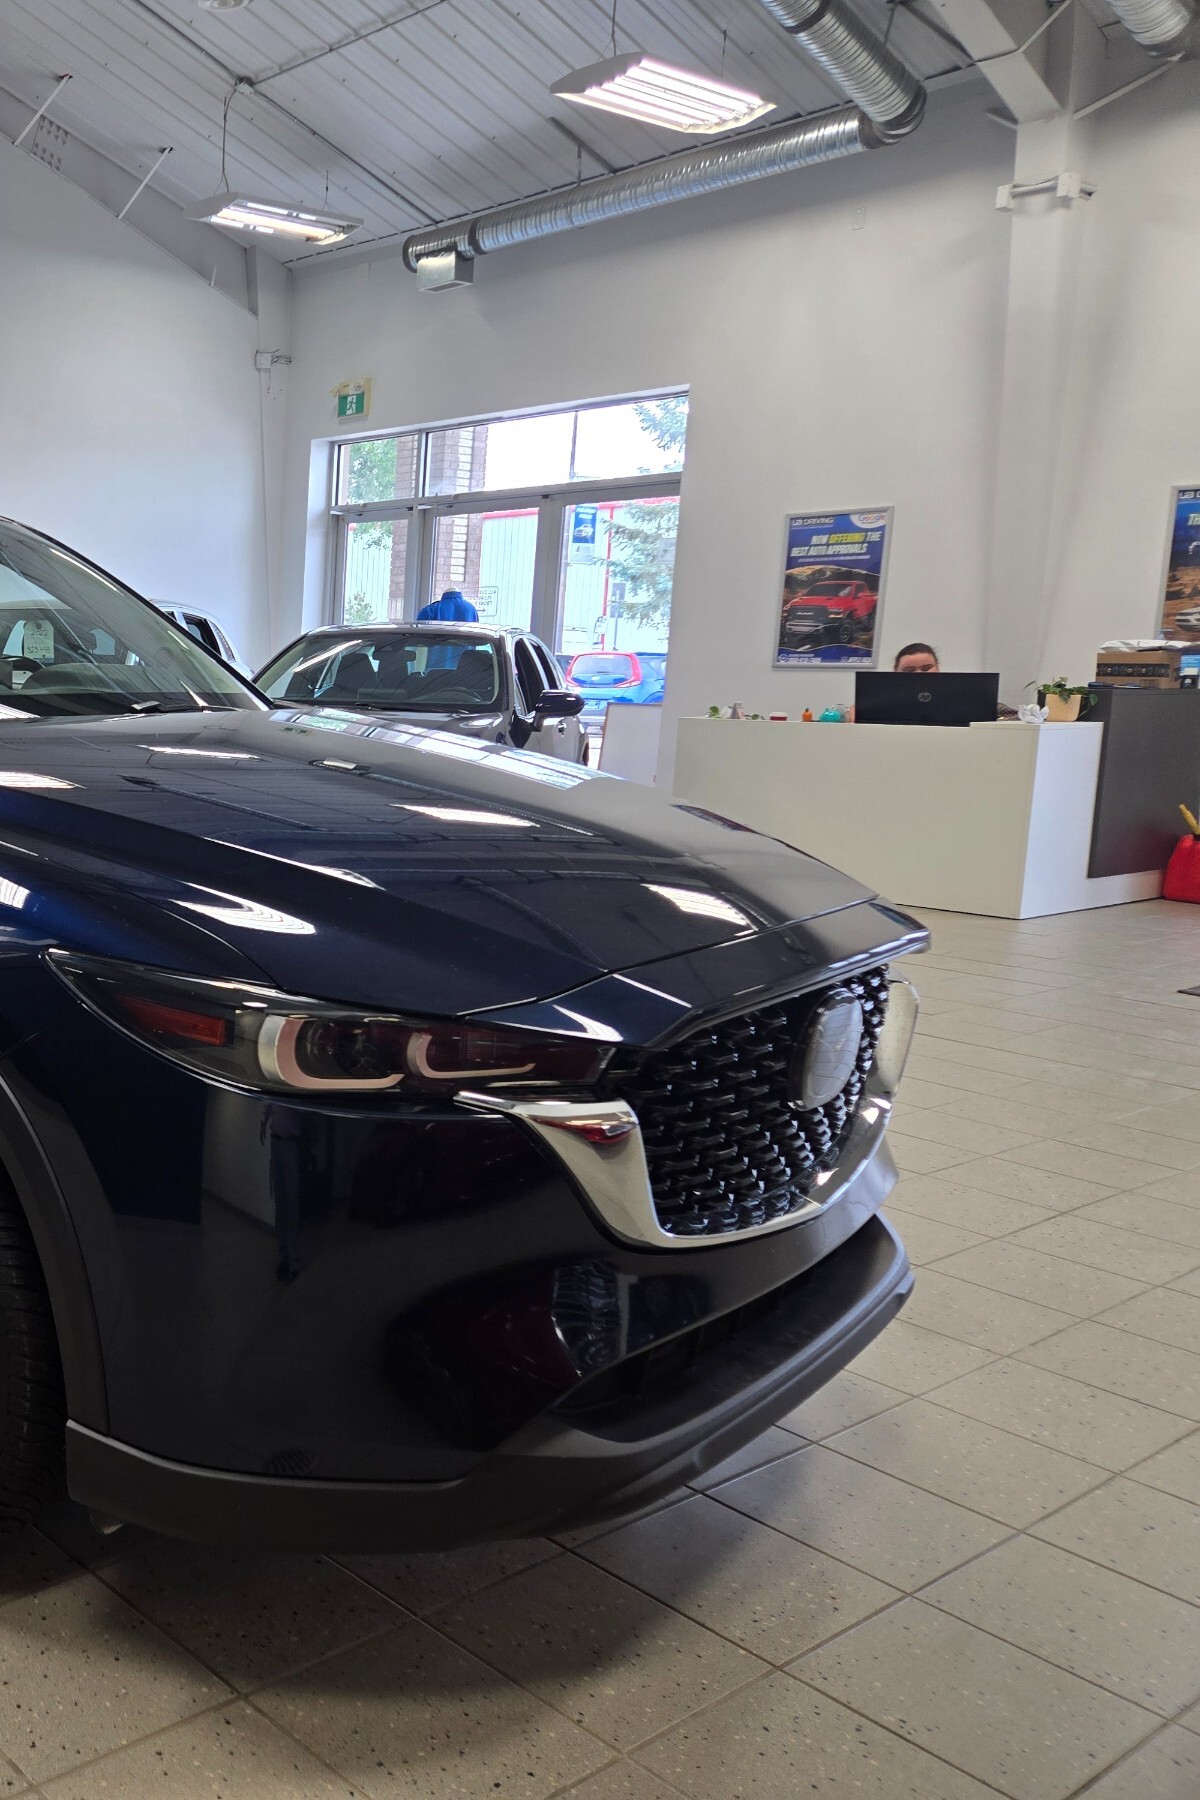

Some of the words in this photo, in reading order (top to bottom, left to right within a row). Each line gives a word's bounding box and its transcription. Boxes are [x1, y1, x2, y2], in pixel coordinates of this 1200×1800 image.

[811, 534, 828, 544] NOW
[828, 532, 865, 543] OFFERING
[866, 531, 882, 542] THE
[790, 546, 810, 557] BEST
[808, 545, 827, 556] AUTO
[826, 543, 868, 555] APPROVALS
